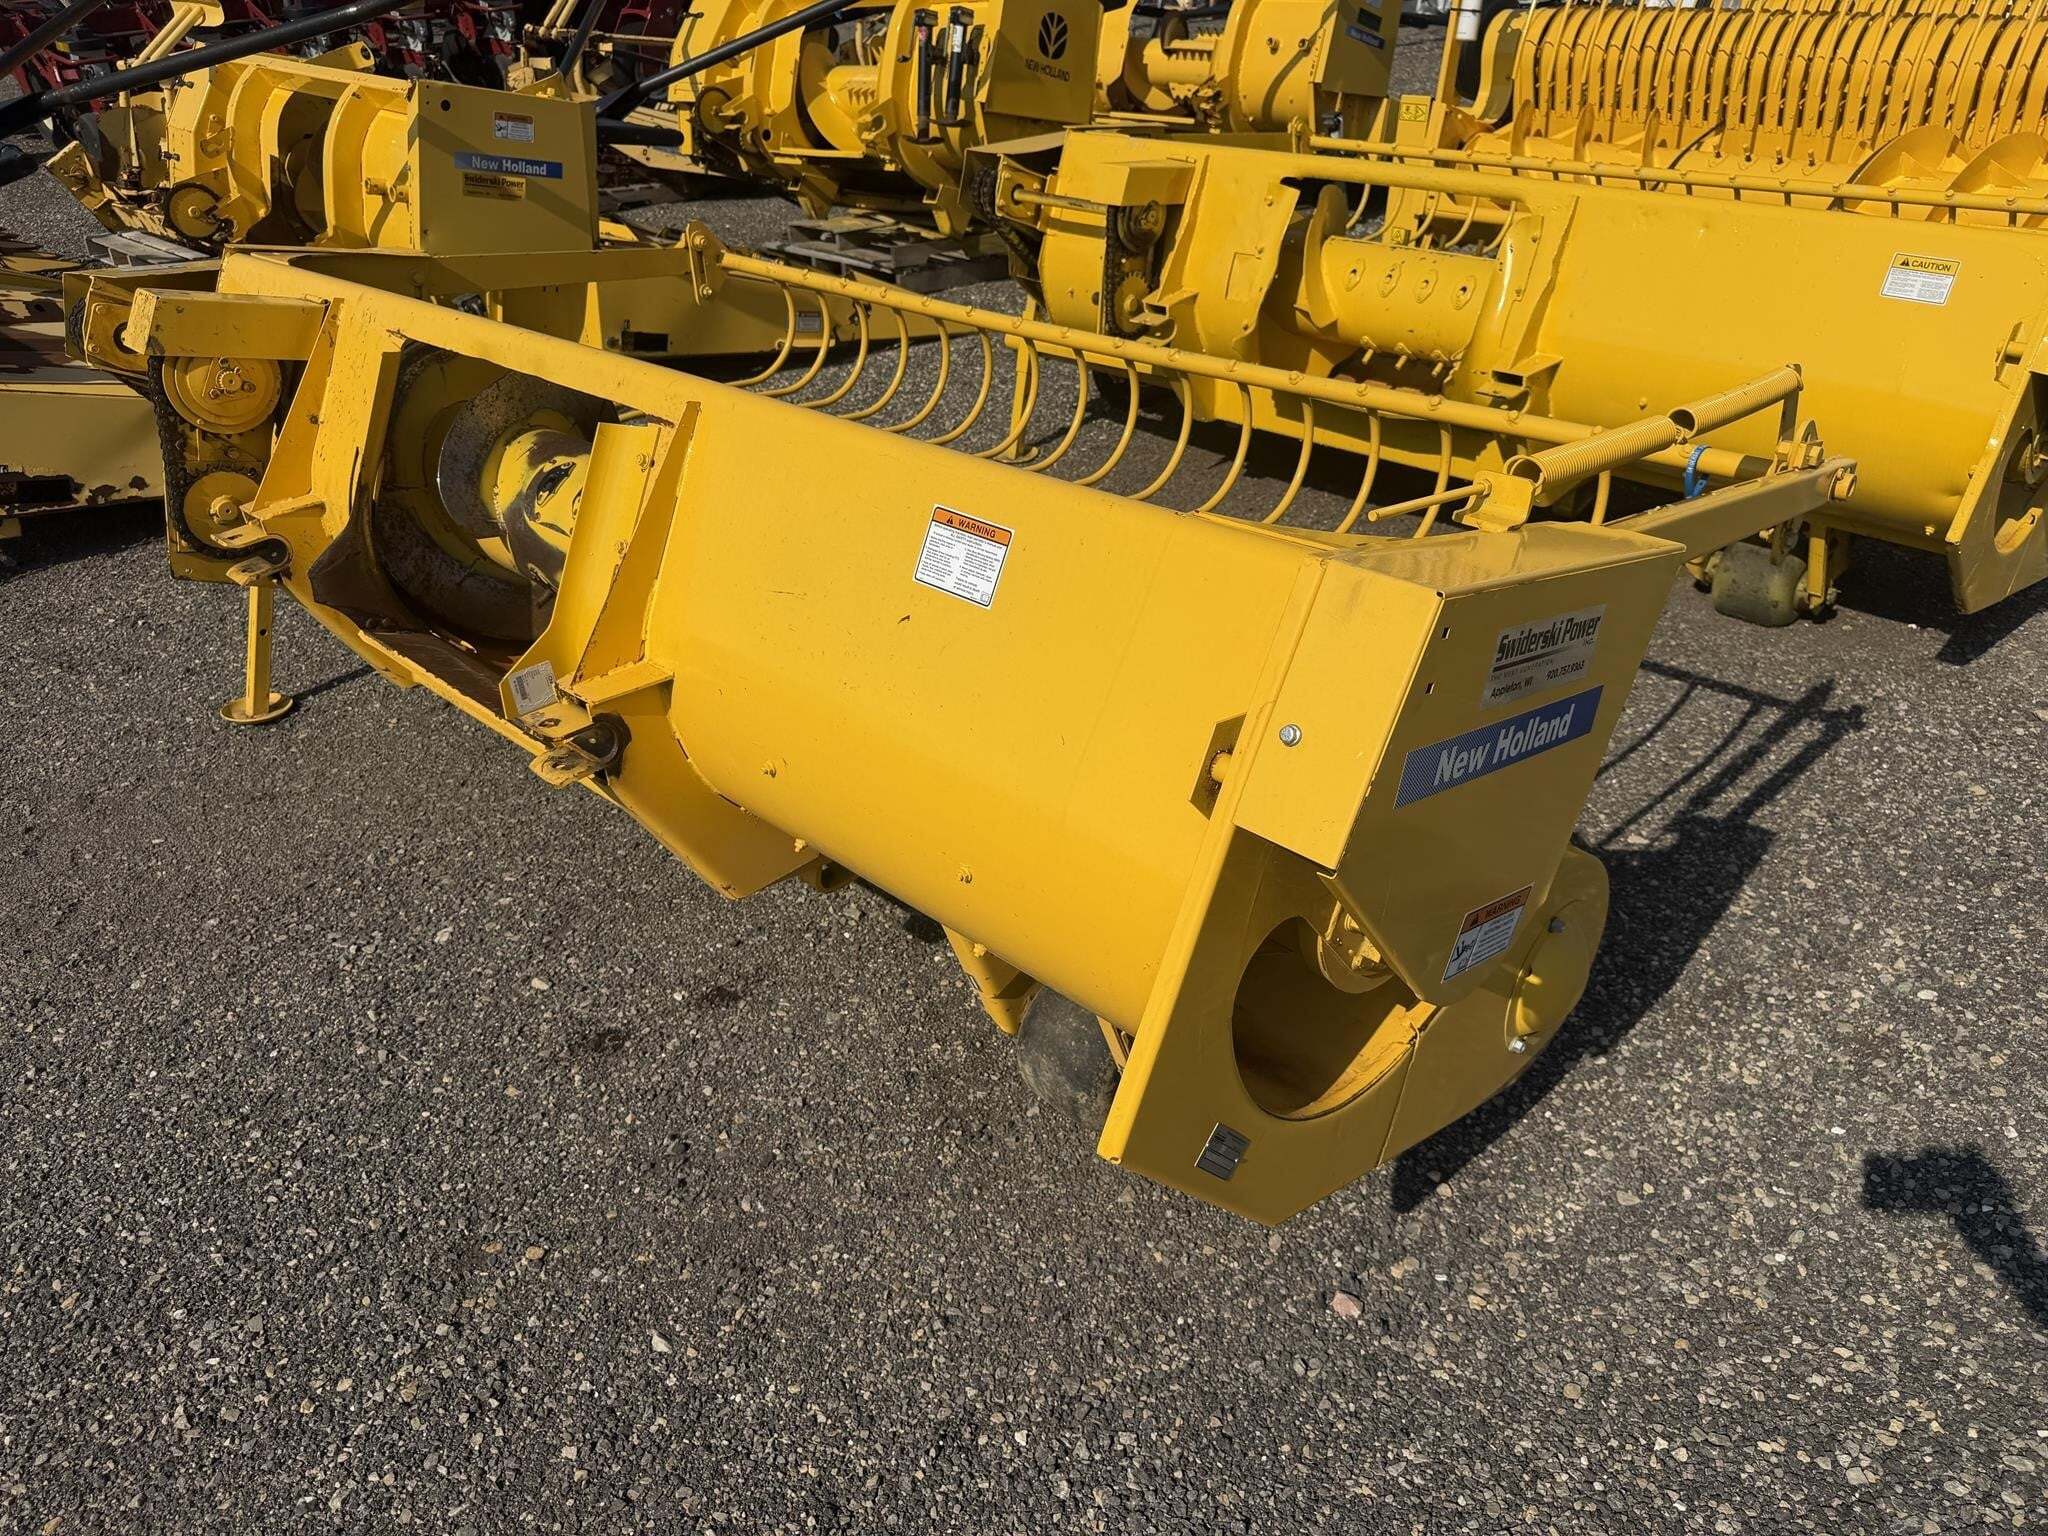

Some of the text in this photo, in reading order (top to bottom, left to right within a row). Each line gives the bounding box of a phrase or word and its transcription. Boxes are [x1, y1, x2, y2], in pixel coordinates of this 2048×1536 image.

[471, 156, 547, 176] New Holland
[501, 177, 525, 189] Power
[1911, 260, 1951, 272] CAUTION
[958, 518, 996, 538] WARNING
[1496, 616, 1602, 662] Swiderski Power
[1433, 704, 1575, 786] New Holland
